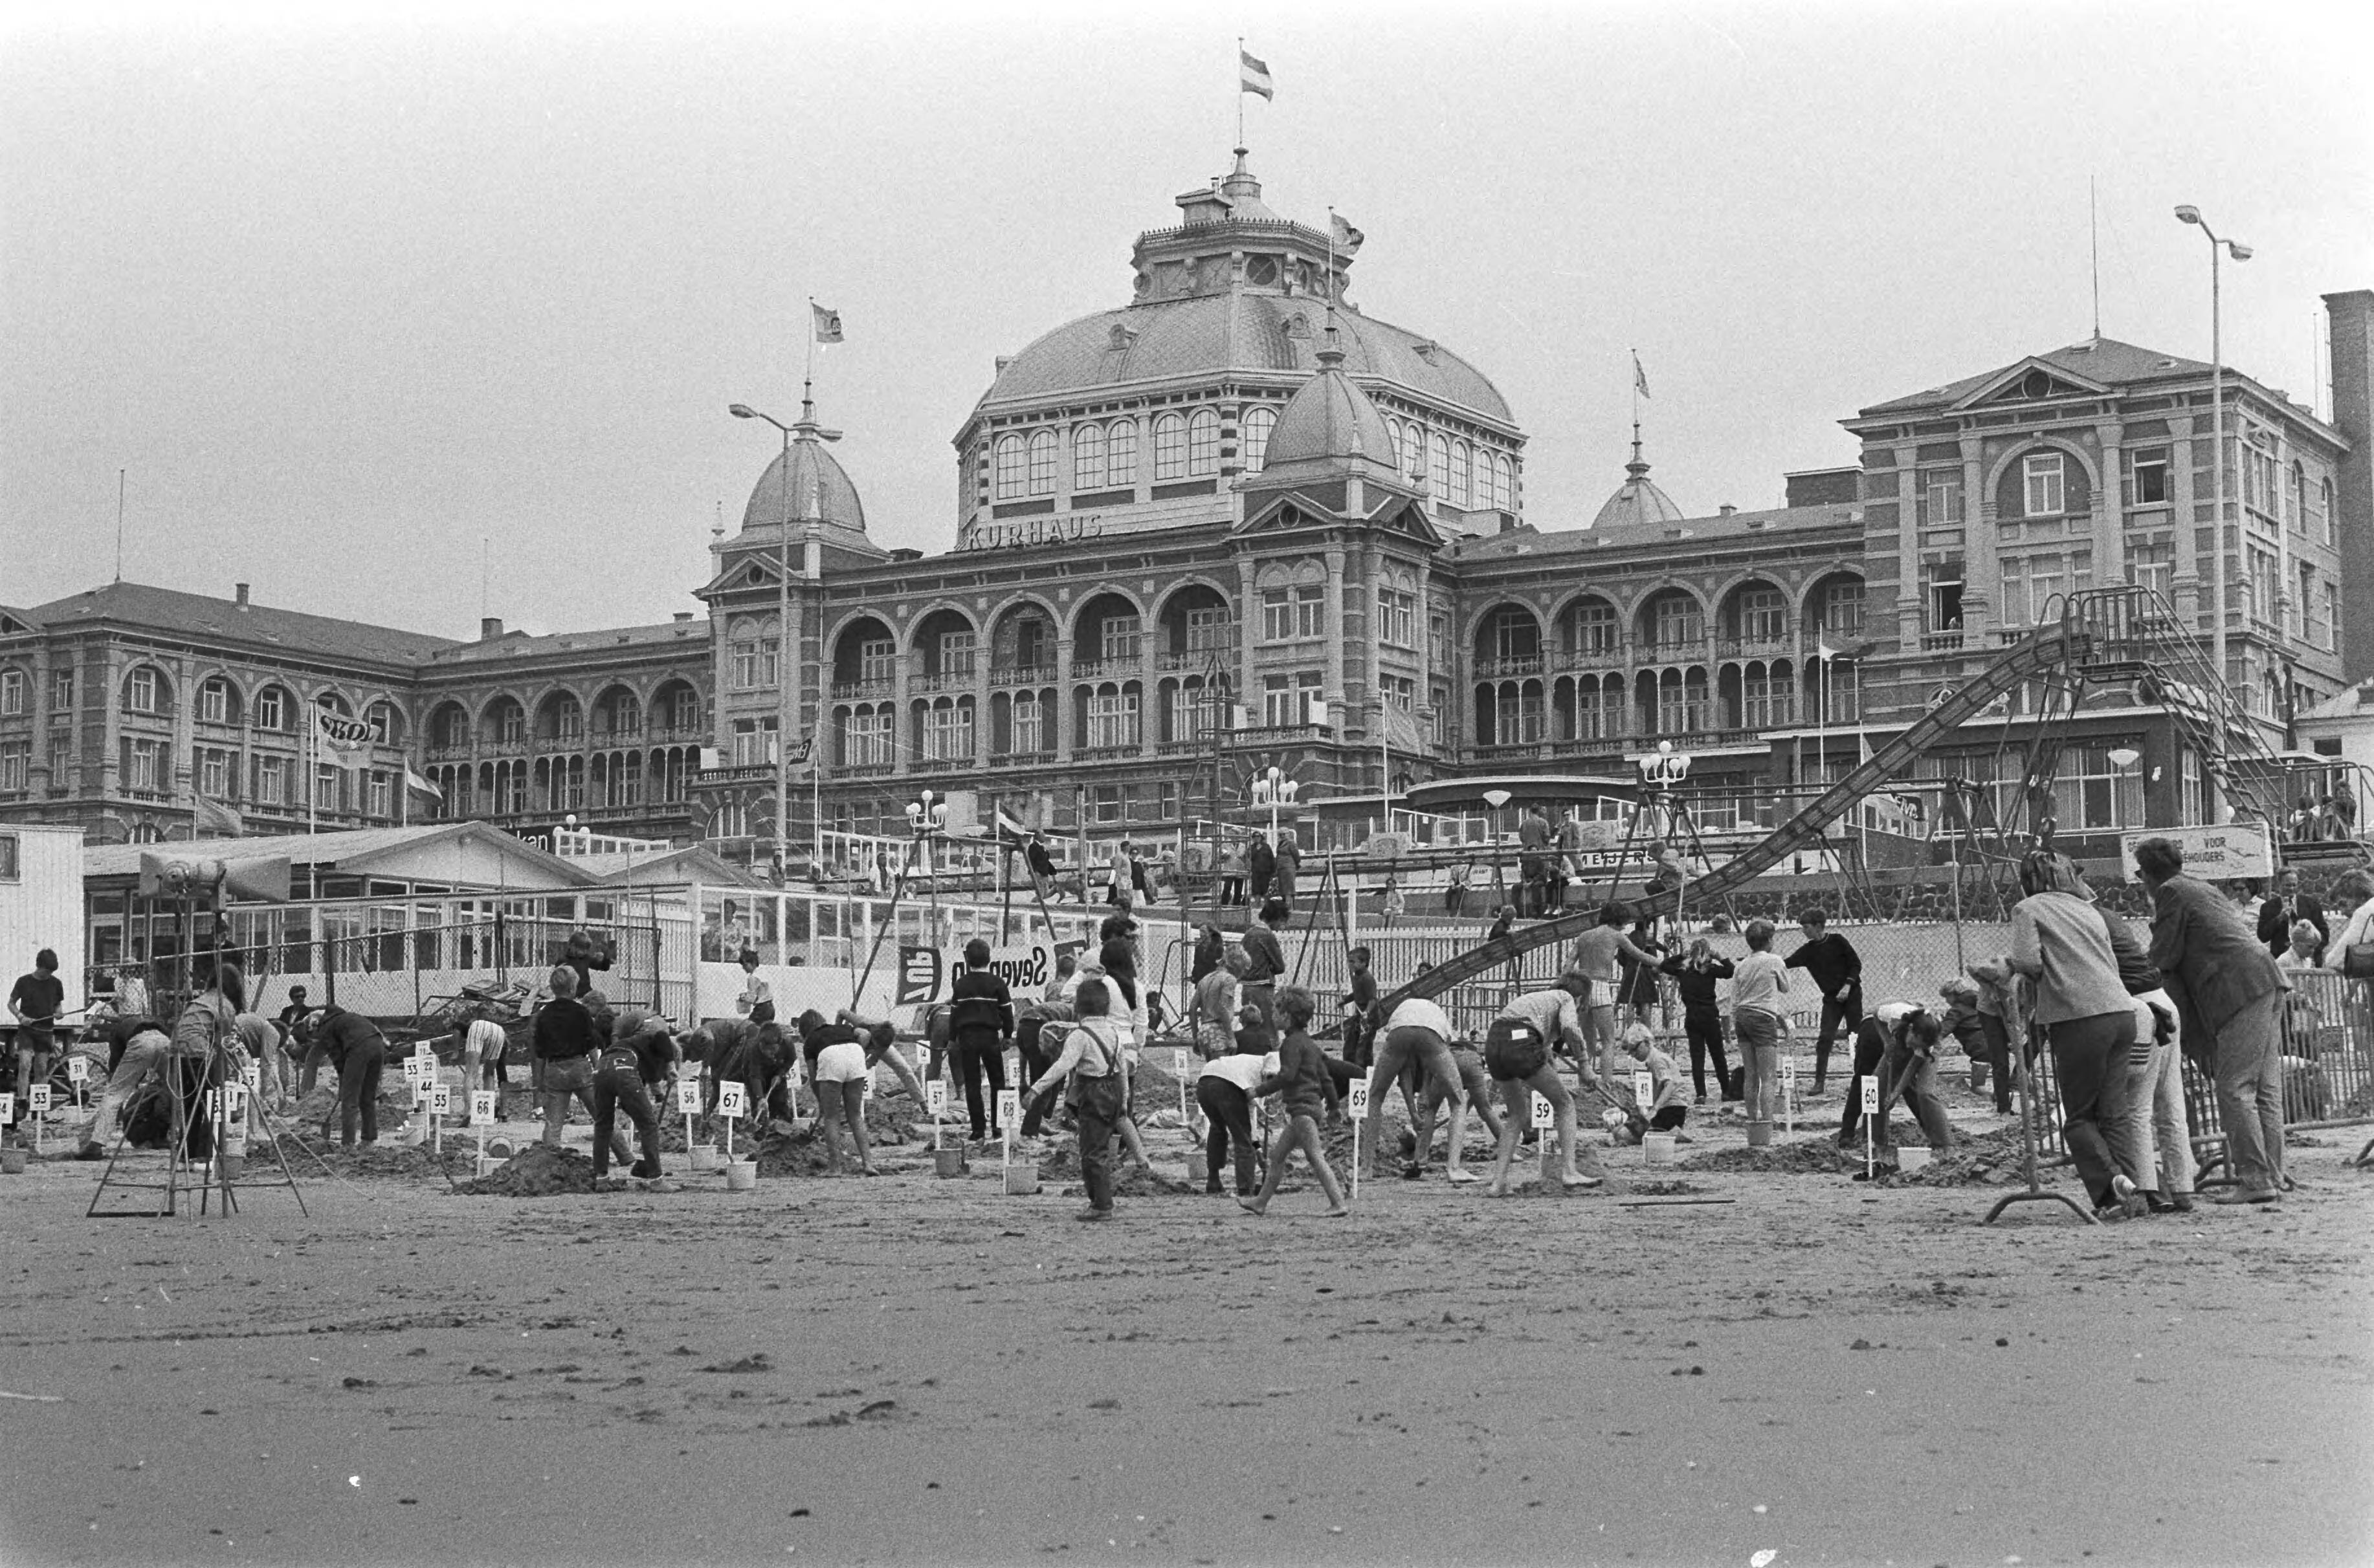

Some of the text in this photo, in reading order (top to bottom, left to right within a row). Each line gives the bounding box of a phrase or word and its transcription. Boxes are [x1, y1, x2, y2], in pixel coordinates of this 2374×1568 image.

[970, 515, 1101, 549] KURHAUS
[320, 715, 373, 742] SKOL
[2204, 837, 2226, 848] VOOR
[74, 1065, 82, 1073] 31
[407, 1065, 418, 1075] 33
[425, 1062, 432, 1071] 22
[421, 1081, 432, 1092] 44
[34, 1092, 47, 1104] 53
[435, 1094, 447, 1107] 55
[684, 1092, 695, 1104] 56
[724, 1093, 738, 1107] 67
[933, 1091, 942, 1105] 57
[1353, 1090, 1366, 1106] 69
[1865, 1088, 1876, 1104] 60
[477, 1101, 489, 1114] 66
[1536, 1103, 1549, 1118] 59
